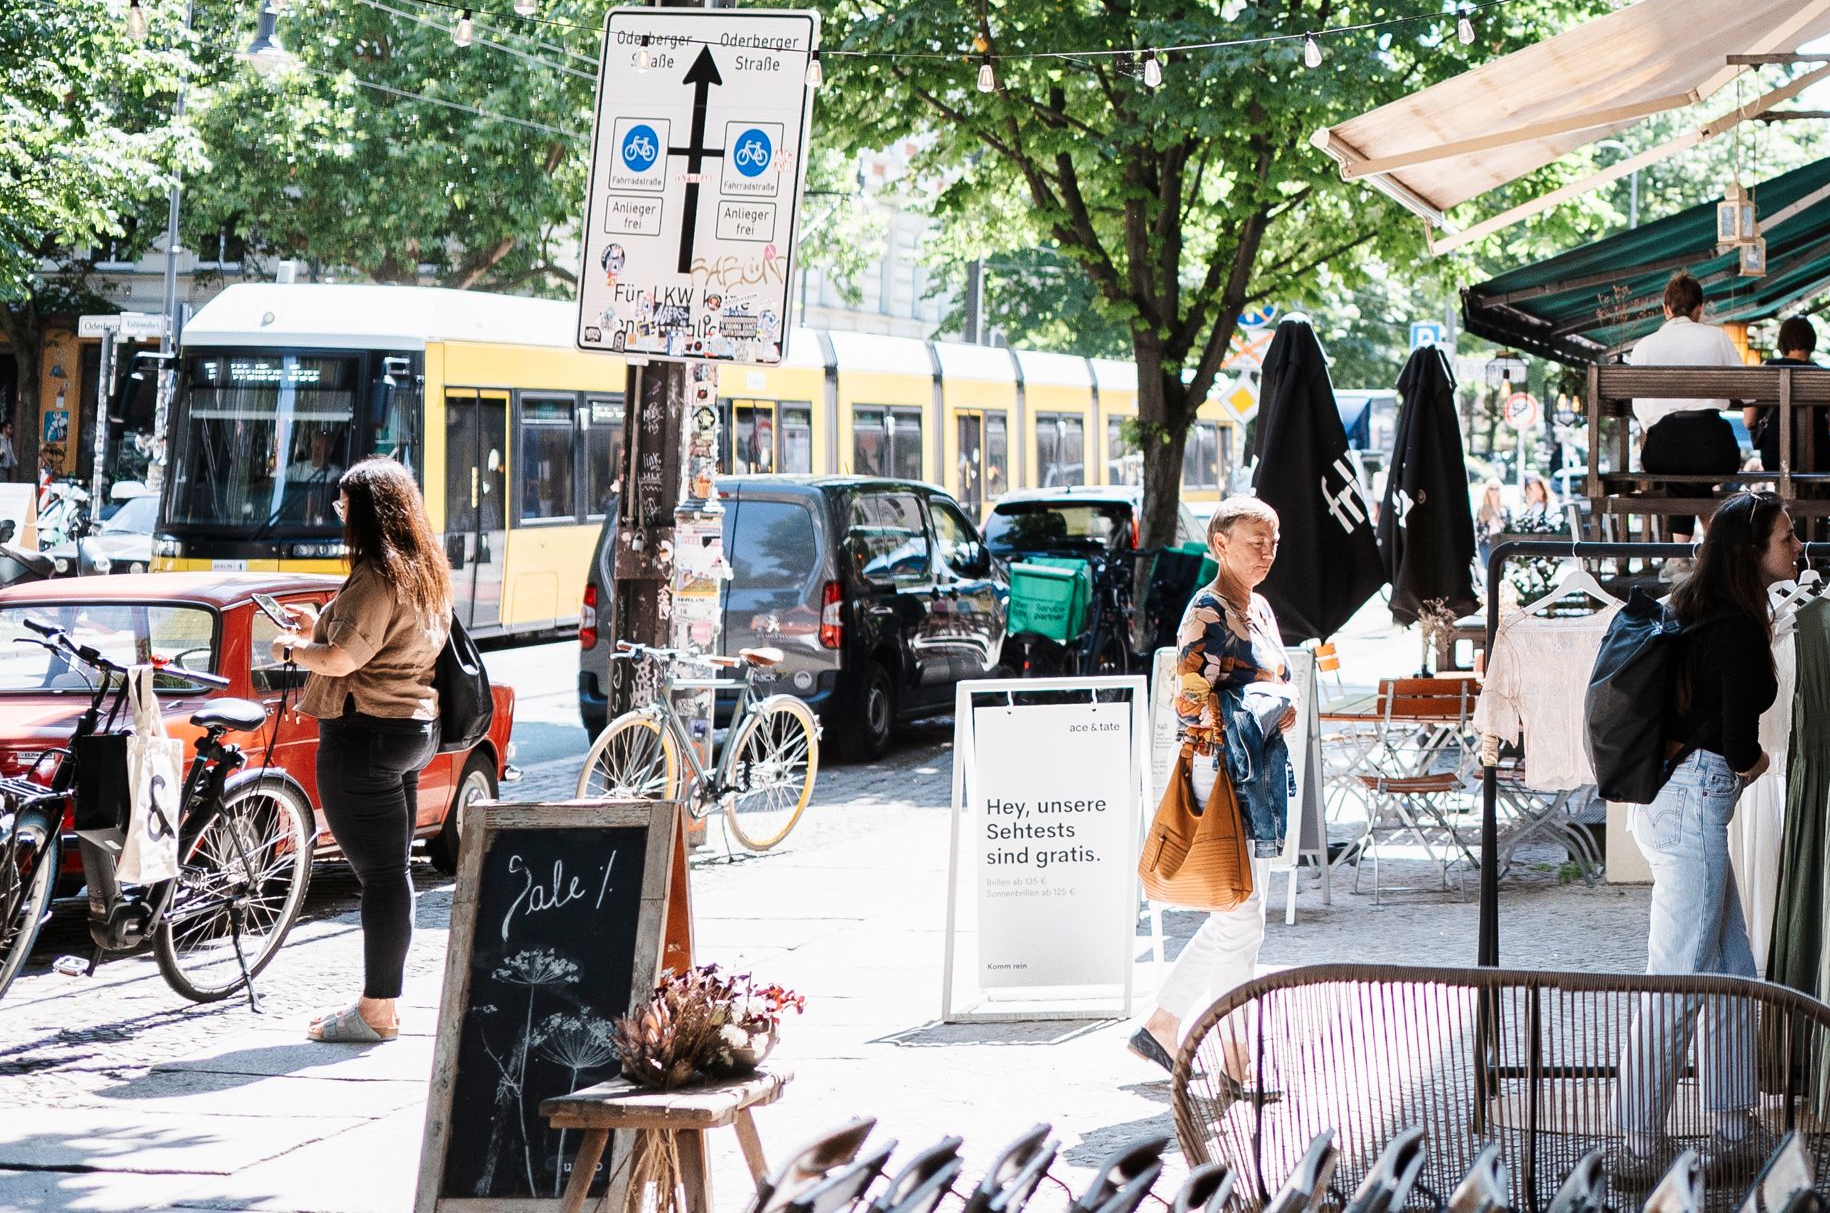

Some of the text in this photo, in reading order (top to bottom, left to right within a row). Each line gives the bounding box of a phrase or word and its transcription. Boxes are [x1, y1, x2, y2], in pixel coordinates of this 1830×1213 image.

[720, 33, 799, 52] Oderberger
[735, 56, 780, 72] Straße
[612, 176, 662, 187] Fahrradstraße
[724, 182, 775, 192] Fahrradstraße
[612, 202, 656, 218] Anlieger
[724, 207, 769, 223] Anlieger
[624, 217, 642, 229] frei
[736, 224, 755, 236] frei
[614, 283, 644, 304] Für
[1069, 722, 1121, 733] ace & tate
[987, 798, 1107, 820] Hey, unsere
[987, 822, 1076, 840] Sehtests
[987, 845, 1101, 869] sind gratis.
[986, 878, 1011, 887] Brillen
[1012, 878, 1023, 886] ab
[501, 854, 586, 943] Sale
[987, 961, 1028, 970] Komm rein
